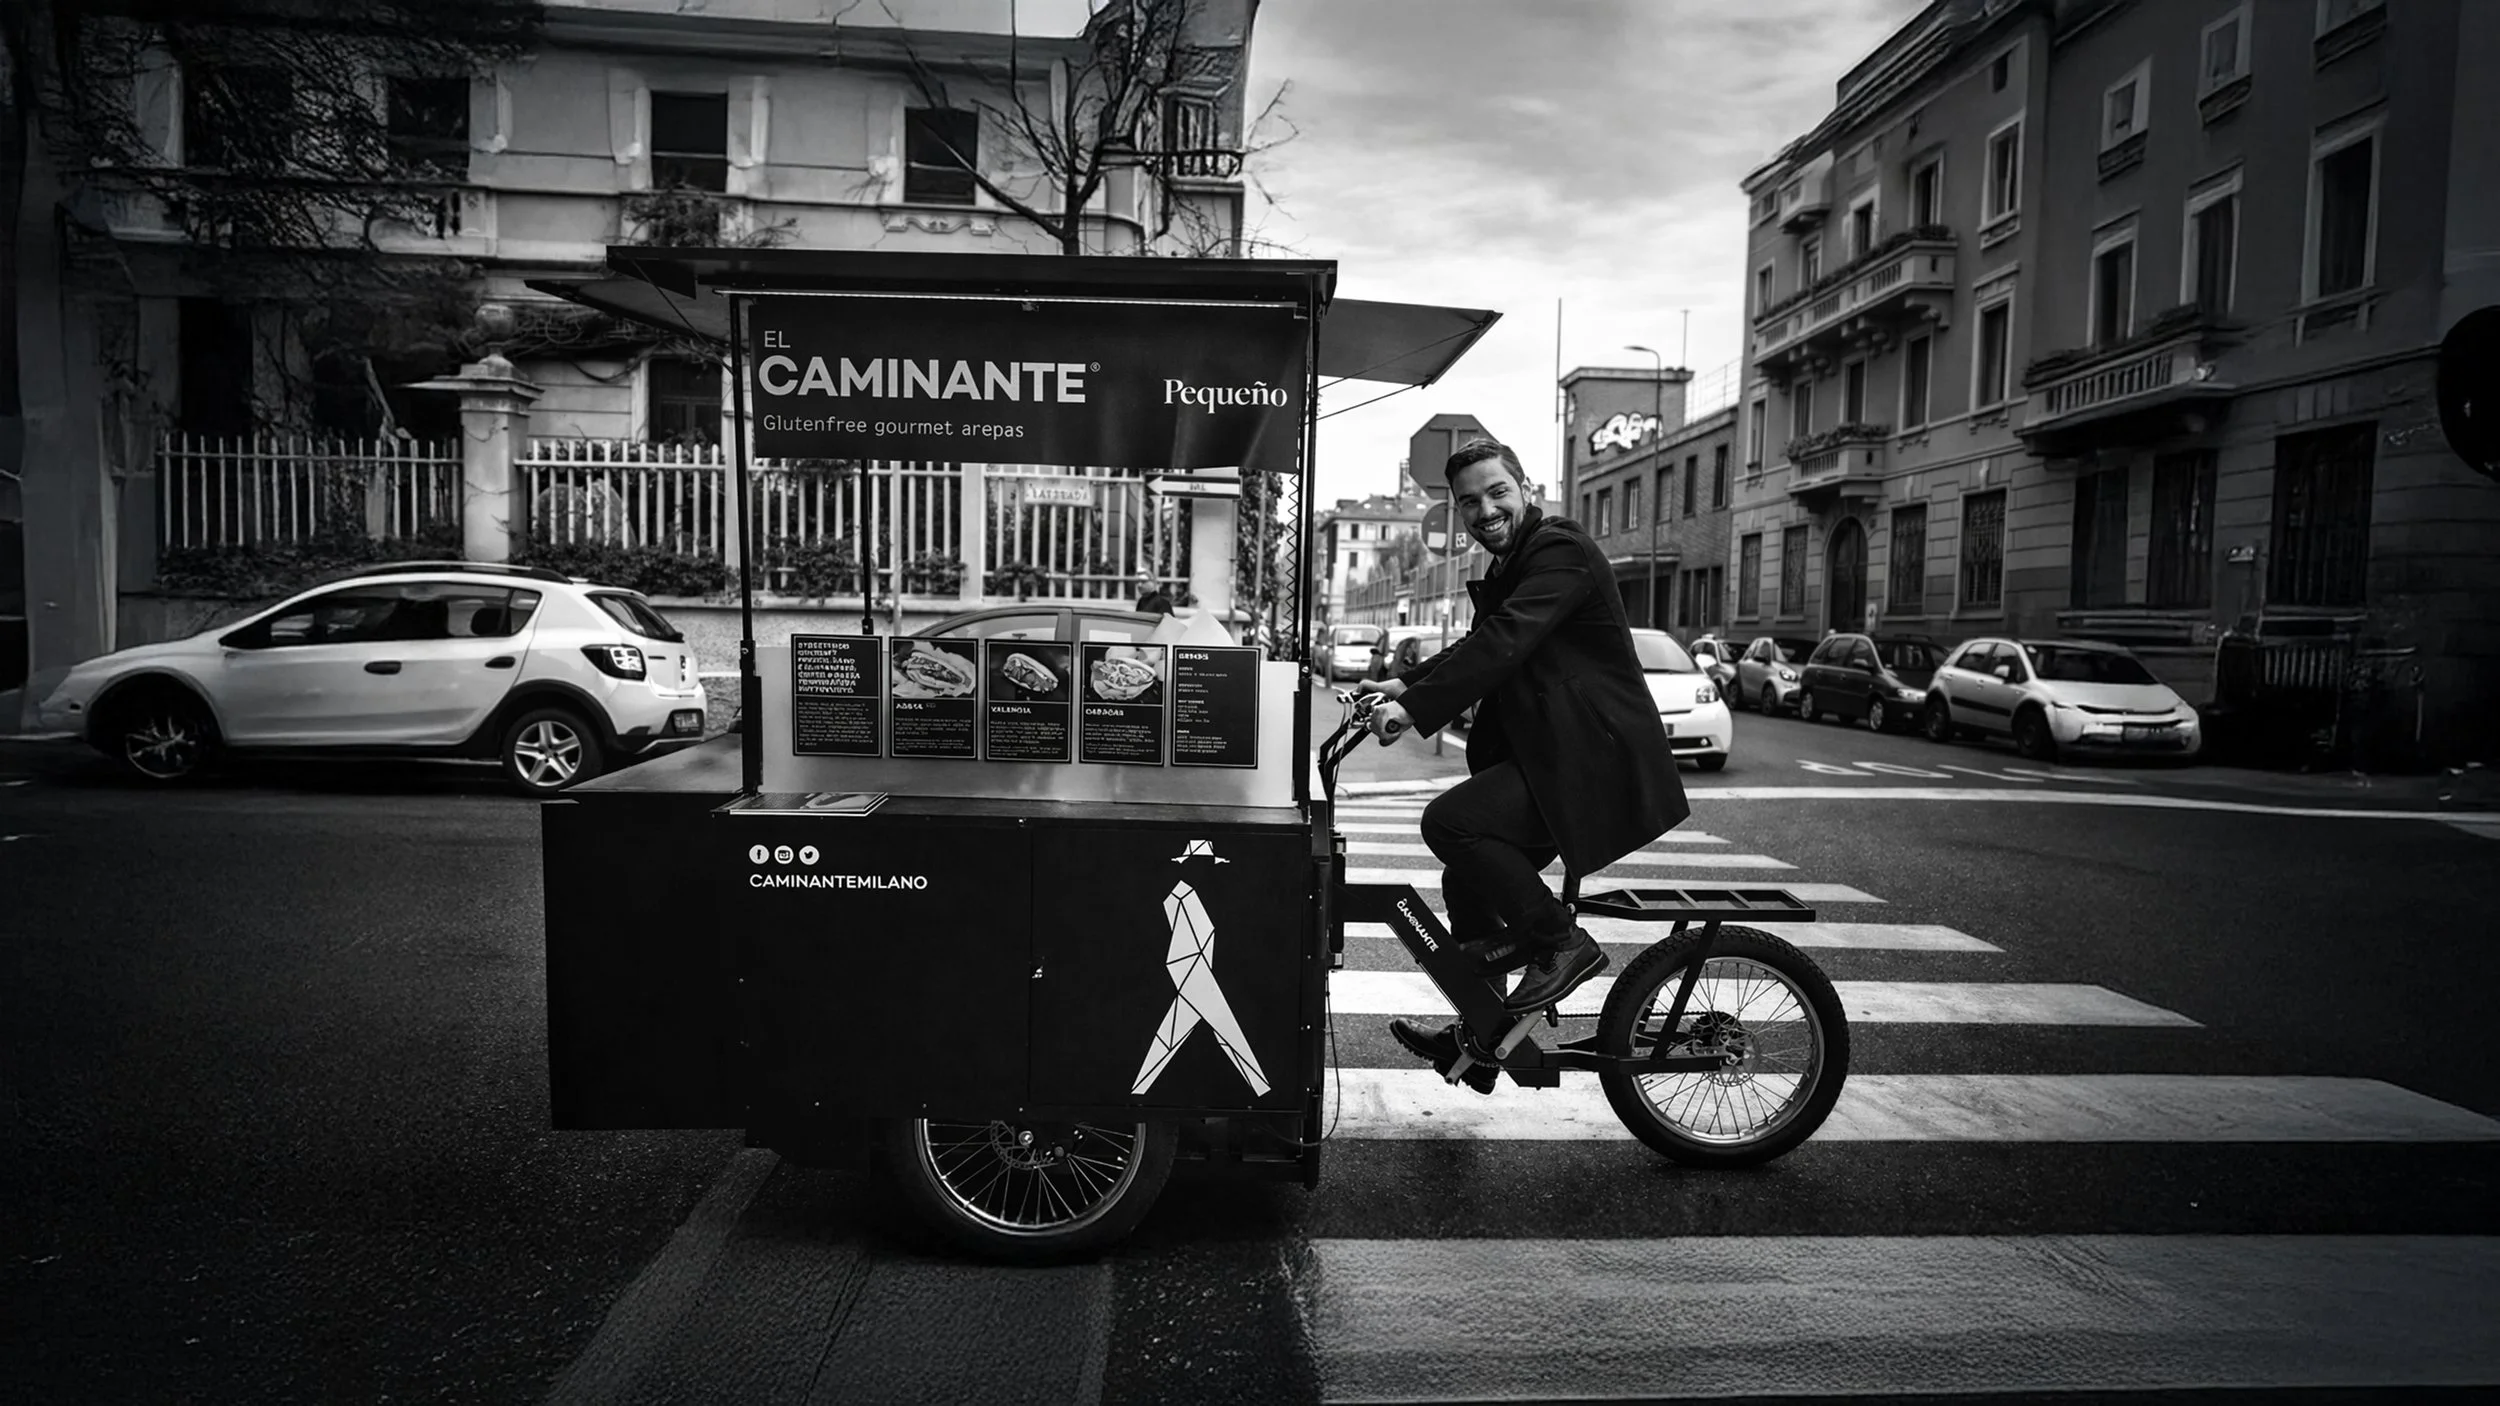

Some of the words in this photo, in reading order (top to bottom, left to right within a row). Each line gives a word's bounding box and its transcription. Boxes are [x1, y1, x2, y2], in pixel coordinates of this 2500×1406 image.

[764, 330, 791, 349] EL
[1164, 378, 1288, 414] Pequeño
[763, 414, 868, 434] Glutenfree
[874, 419, 954, 438] gourmet
[961, 423, 1024, 440] arepas
[749, 873, 928, 890] CAMINANTEMILANO
